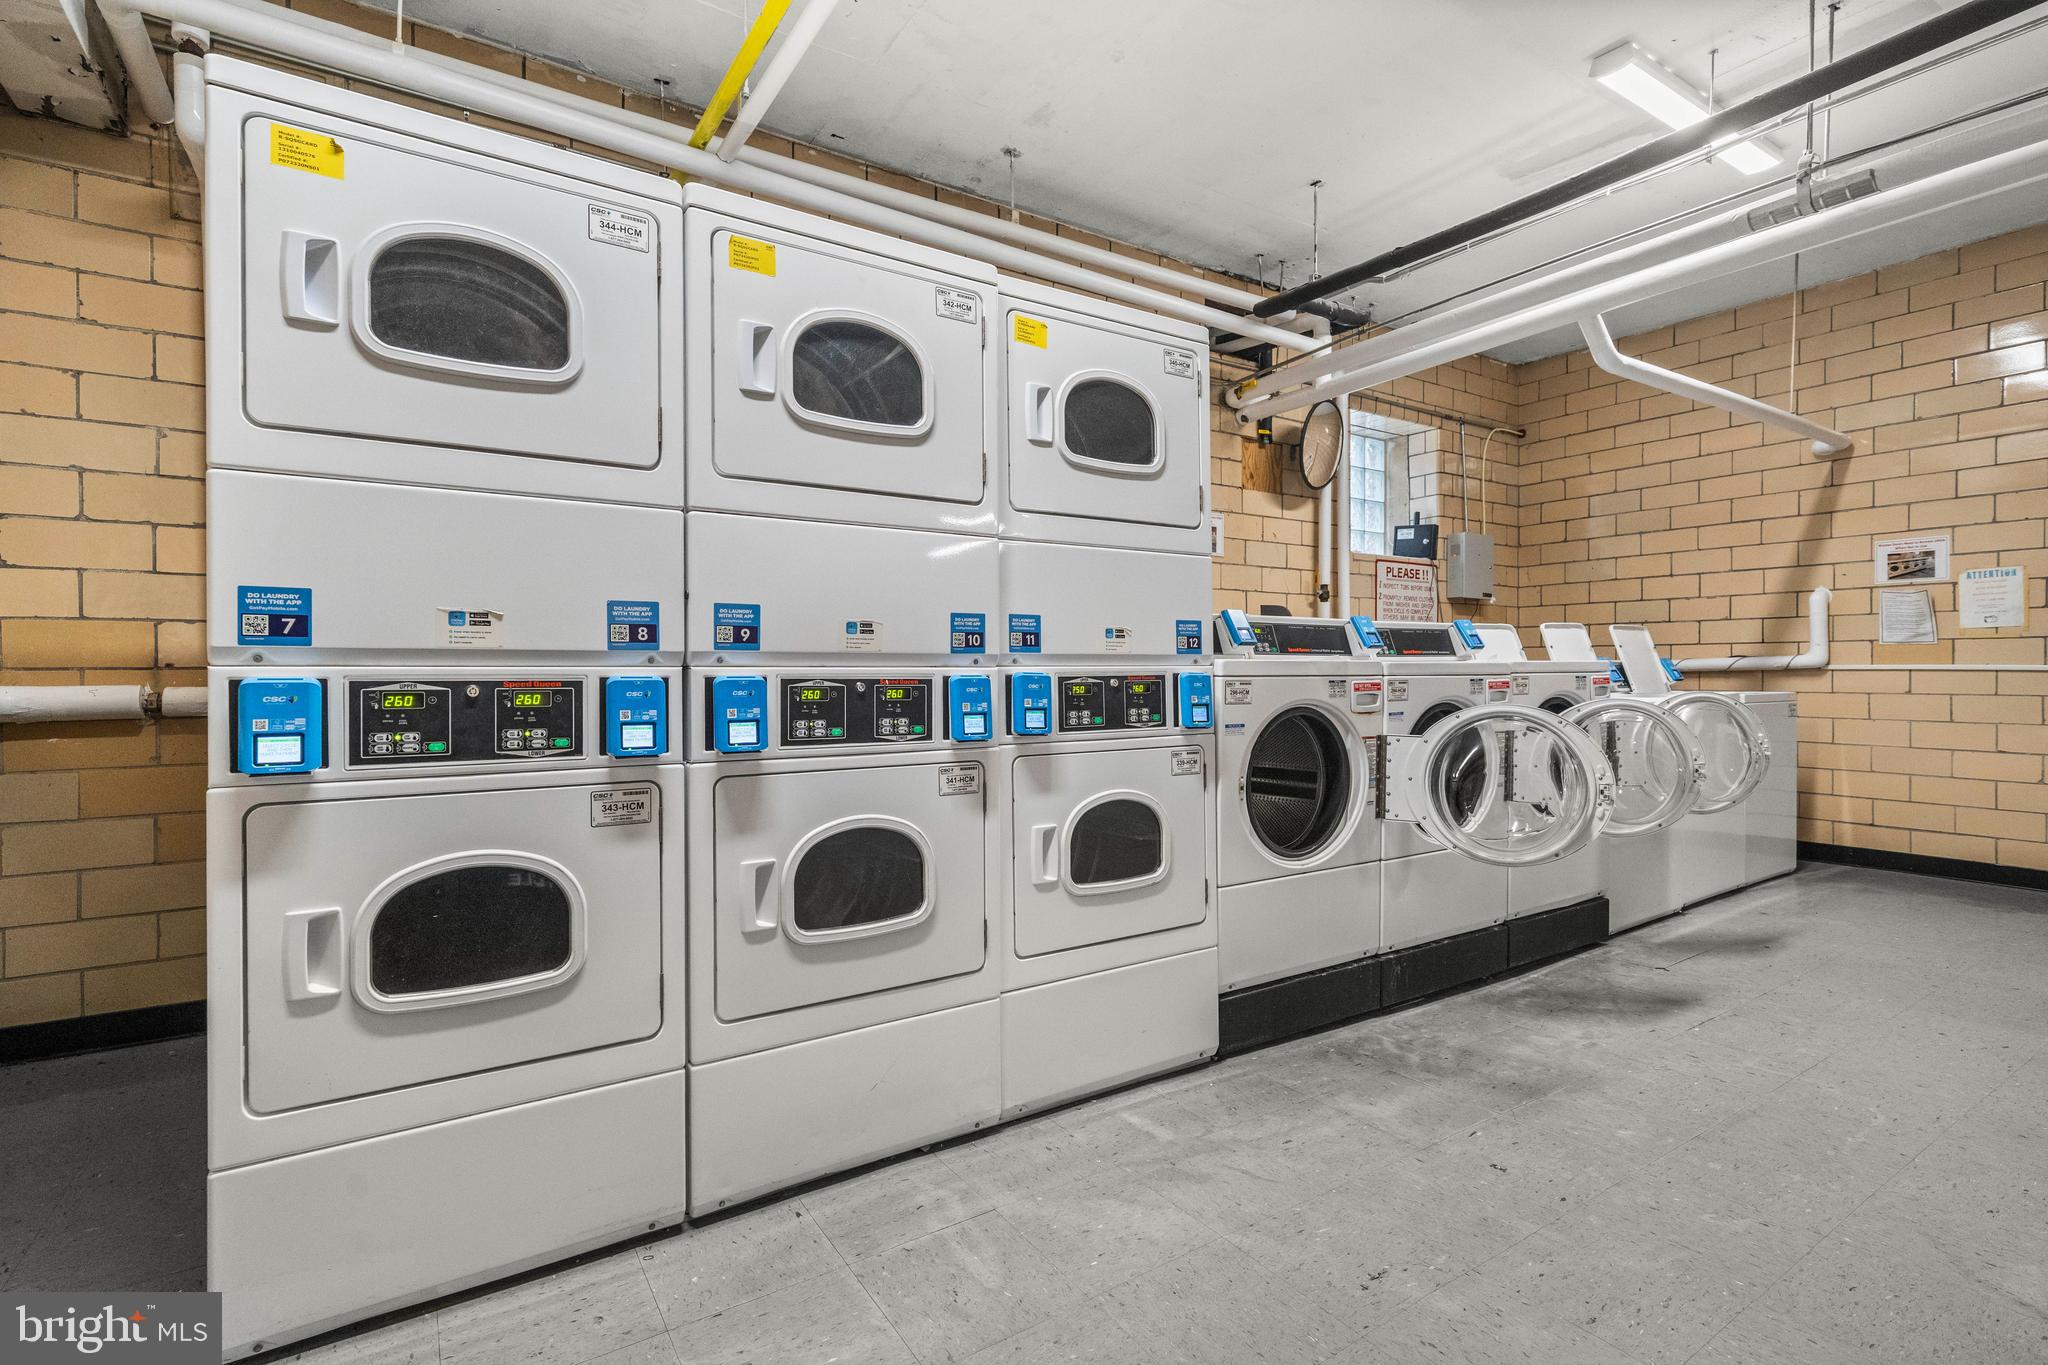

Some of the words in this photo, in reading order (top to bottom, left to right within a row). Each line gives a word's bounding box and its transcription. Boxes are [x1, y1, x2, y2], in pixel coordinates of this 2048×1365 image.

[591, 207, 606, 215] CSC
[599, 220, 642, 238] 344-HCM
[943, 299, 972, 312] 342-HCM
[1386, 566, 1420, 580] PLEASE
[1966, 568, 2017, 580] ATTENTION
[282, 618, 296, 635] 7
[638, 627, 649, 641] 8
[740, 628, 750, 642] 9
[1025, 634, 1035, 646] 11
[967, 634, 981, 647] 10
[1189, 637, 1199, 648] 12
[503, 681, 532, 690] Speed
[533, 680, 562, 689] Queen
[515, 694, 541, 705] 260
[801, 690, 821, 700] 260
[887, 689, 904, 699] 260
[384, 695, 414, 707] 260
[945, 775, 975, 785] 341-HCM
[601, 802, 645, 812] 343-HCM
